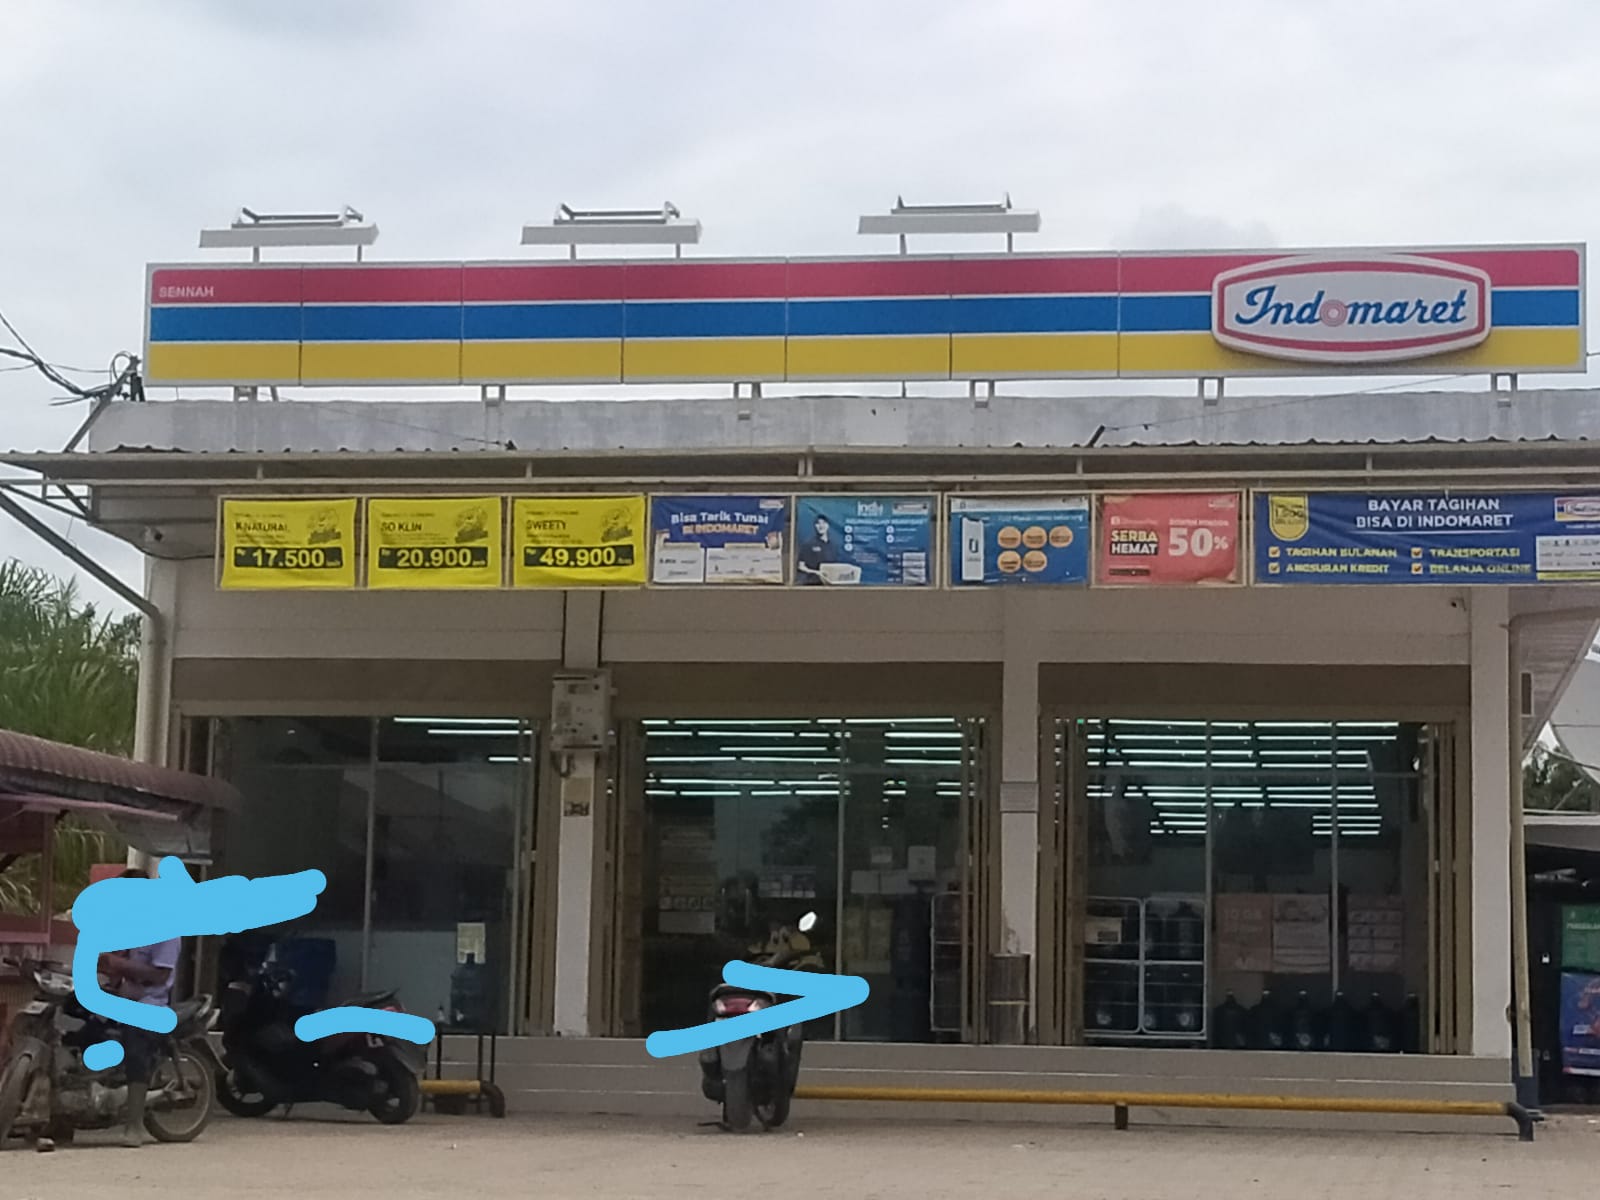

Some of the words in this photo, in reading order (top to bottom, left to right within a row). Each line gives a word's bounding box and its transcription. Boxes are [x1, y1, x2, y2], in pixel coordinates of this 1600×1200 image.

[1234, 285, 1468, 327] Indomaret
[1368, 499, 1423, 511] BAYAR
[1428, 498, 1500, 511] TAGIHAN
[671, 512, 697, 524] Bisa
[700, 510, 730, 522] Tarik
[733, 512, 769, 524] Tunai
[1356, 516, 1393, 528] BISA
[1397, 515, 1412, 527] DI
[1418, 514, 1513, 527] INDOMARET
[526, 519, 567, 531] SWEETY
[1111, 530, 1158, 542] SERBA
[1168, 527, 1229, 557] 50%
[1111, 543, 1158, 554] HEMAT
[253, 549, 325, 567] 17.500
[396, 548, 472, 567] 20.900
[540, 547, 616, 566] 49.900
